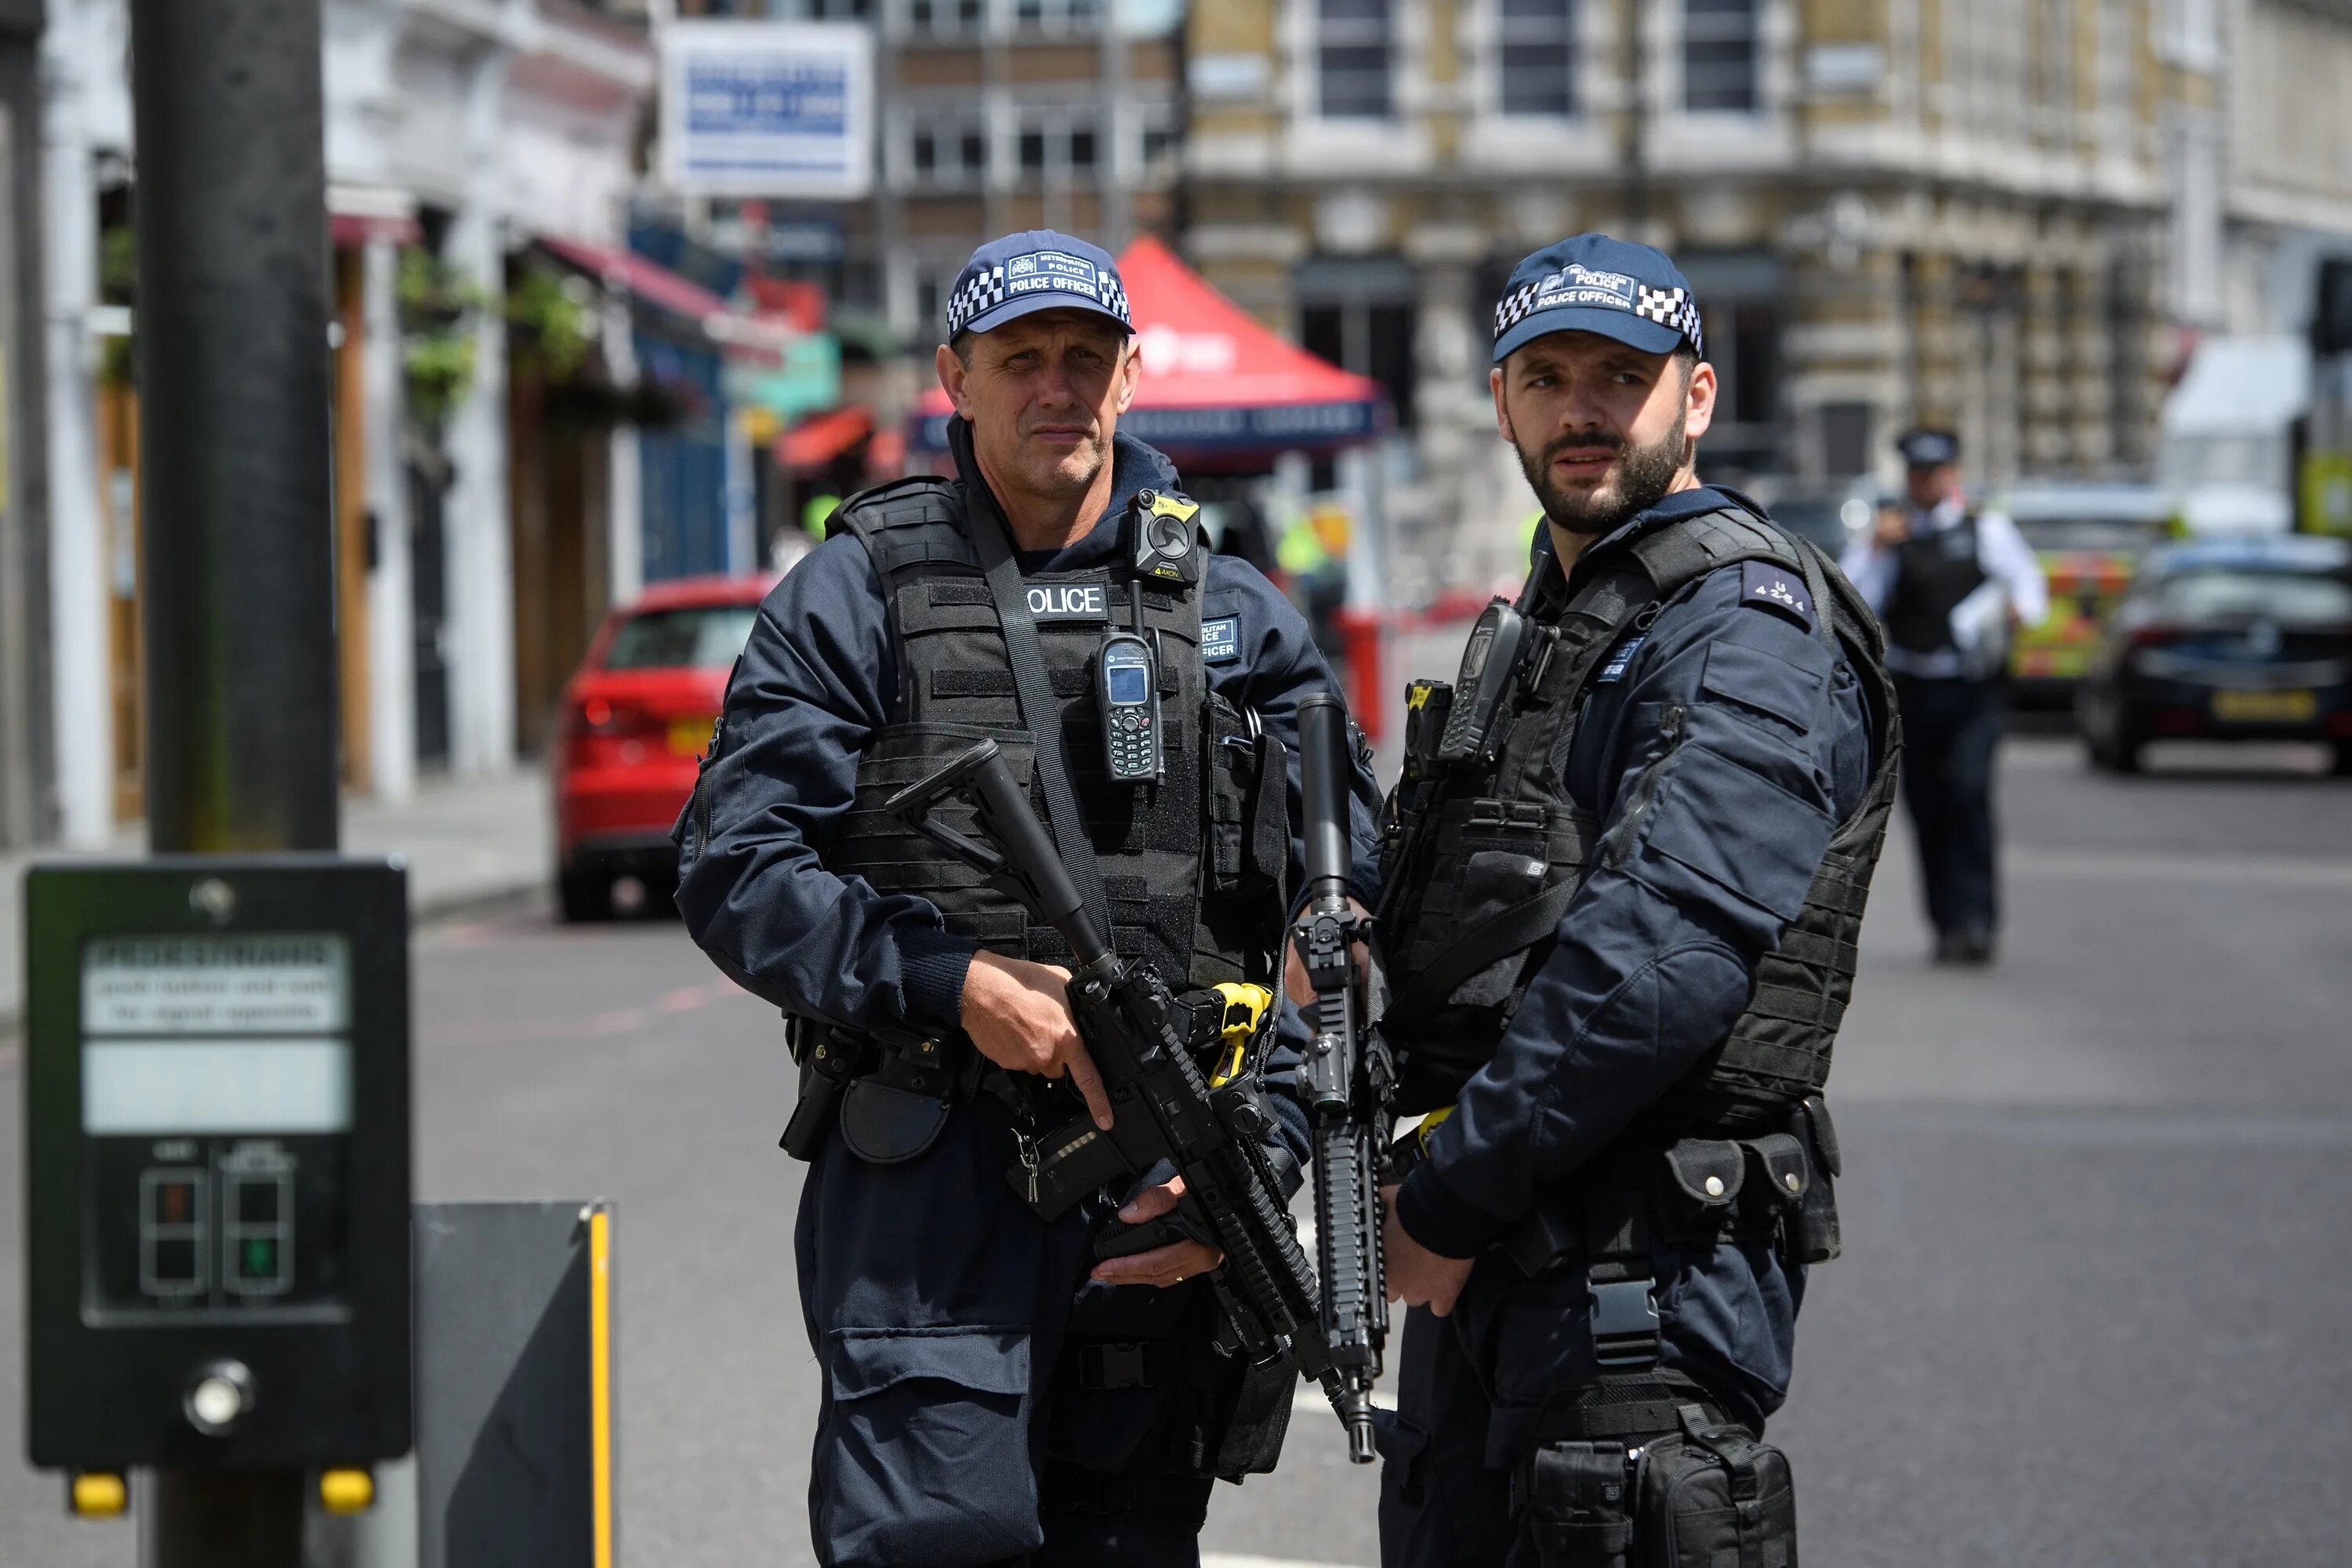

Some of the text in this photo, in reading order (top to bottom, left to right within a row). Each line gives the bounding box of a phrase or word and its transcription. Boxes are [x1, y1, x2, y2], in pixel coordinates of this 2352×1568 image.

[1040, 255, 1091, 269] METROPOLITAN
[1048, 263, 1084, 275] POLICE
[1009, 277, 1097, 298] POLICE OFFICER
[1576, 274, 1618, 291] POLICE
[1537, 291, 1631, 309] POLICE OFFICER
[1161, 569, 1178, 578] AXON
[1027, 587, 1102, 613] OLICE
[1201, 624, 1226, 633] OLITAN
[1201, 631, 1219, 642] ICE
[1202, 644, 1234, 657] FICER
[101, 940, 331, 969] PEDESTRIANS
